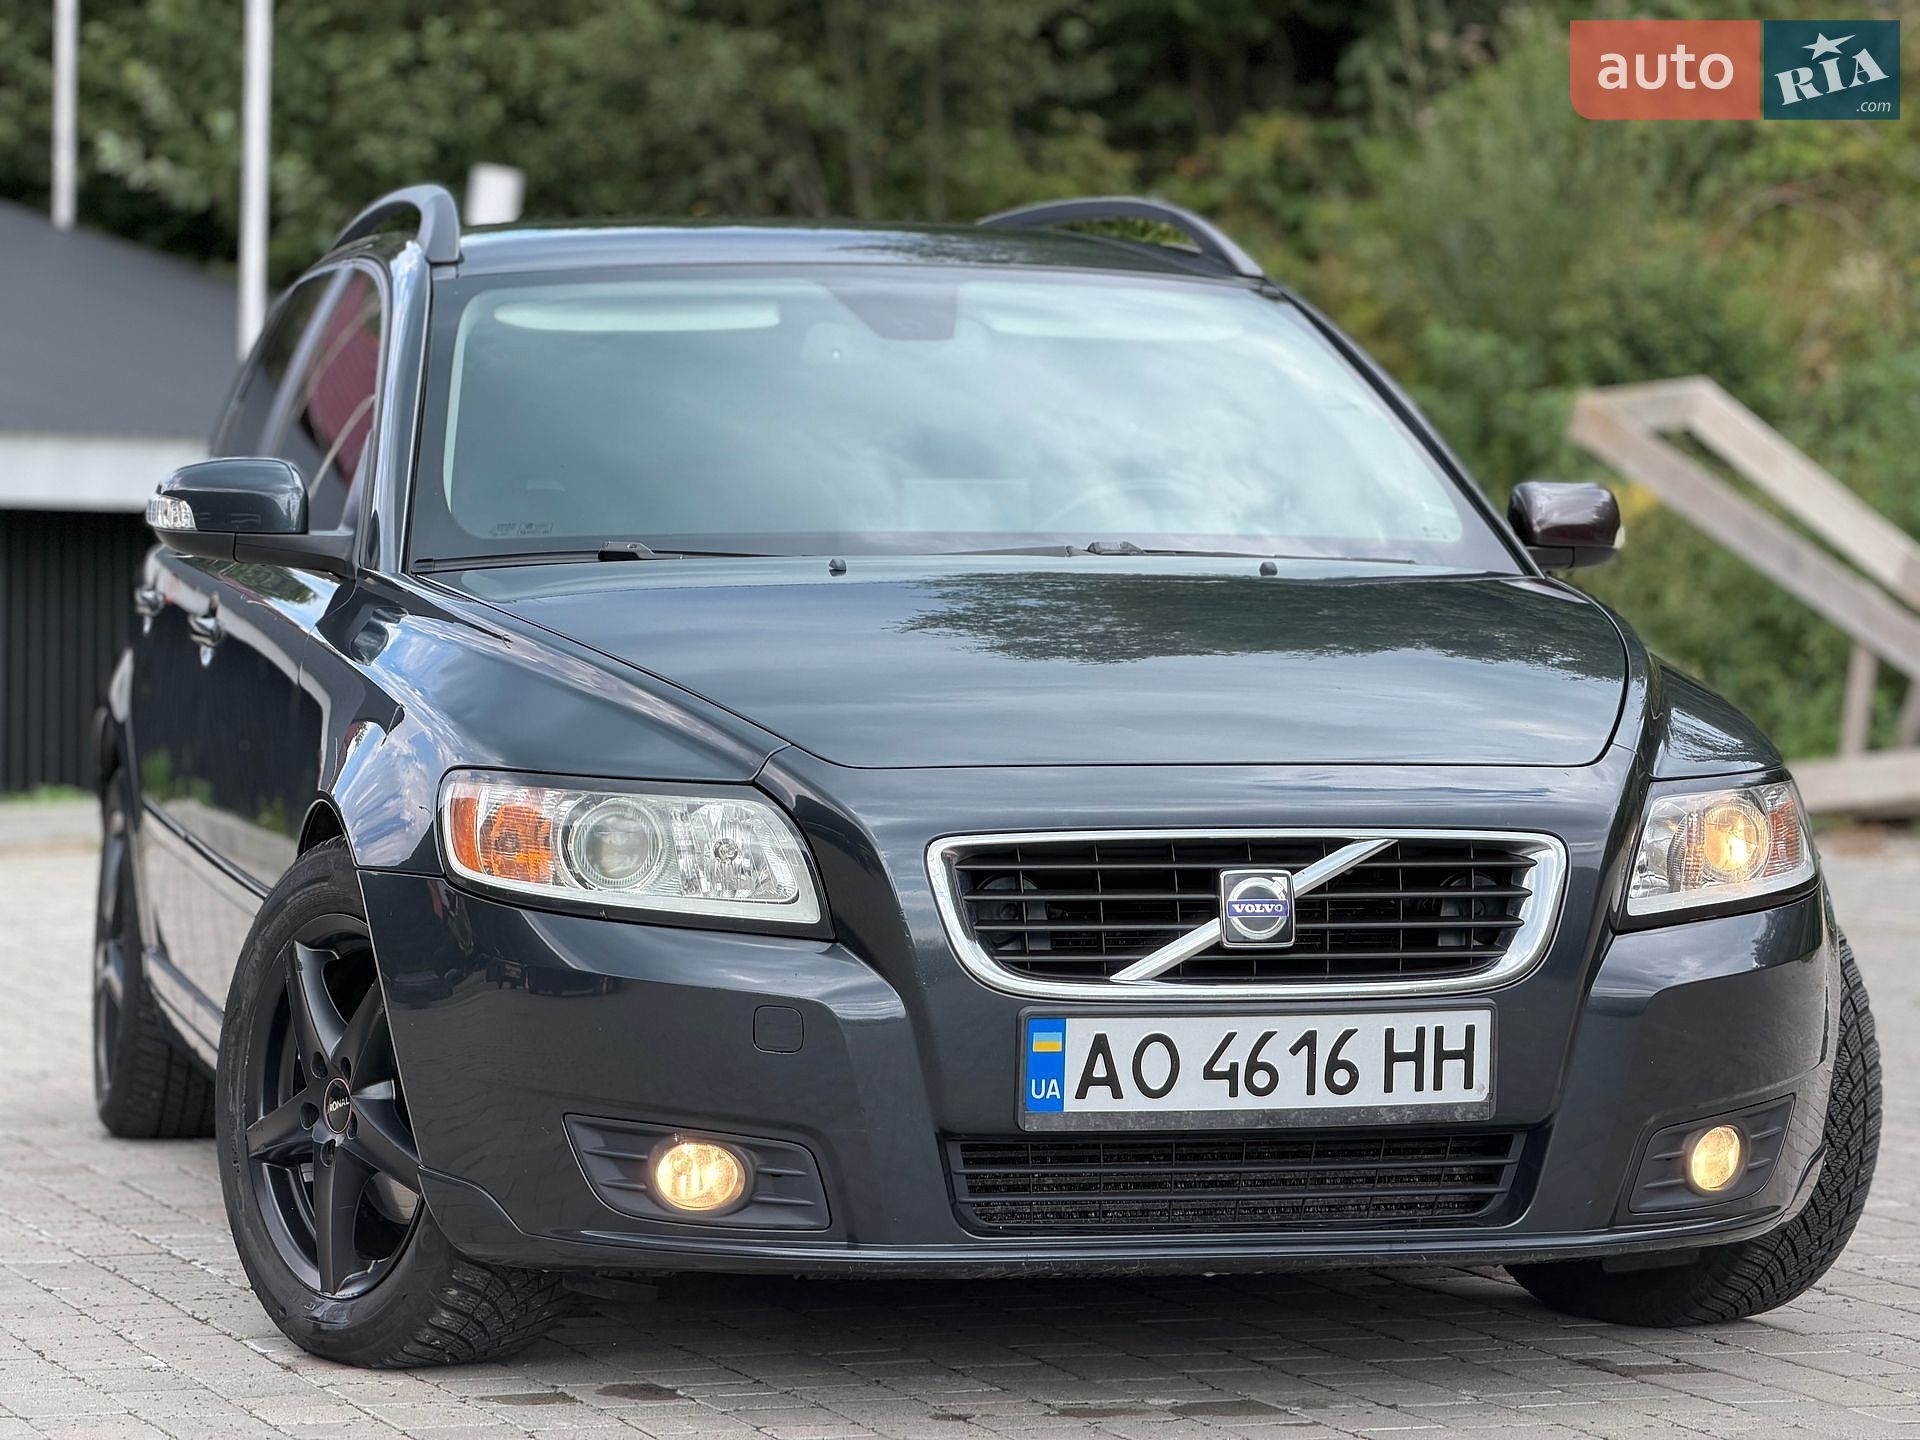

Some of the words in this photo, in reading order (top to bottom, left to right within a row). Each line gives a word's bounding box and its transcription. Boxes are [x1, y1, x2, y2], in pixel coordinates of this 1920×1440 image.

[1232, 903, 1284, 913] VOLVO
[1075, 1033, 1180, 1100] AO
[1203, 1028, 1360, 1097] 4616
[1384, 1024, 1475, 1093] HH
[1031, 1079, 1061, 1099] UA
